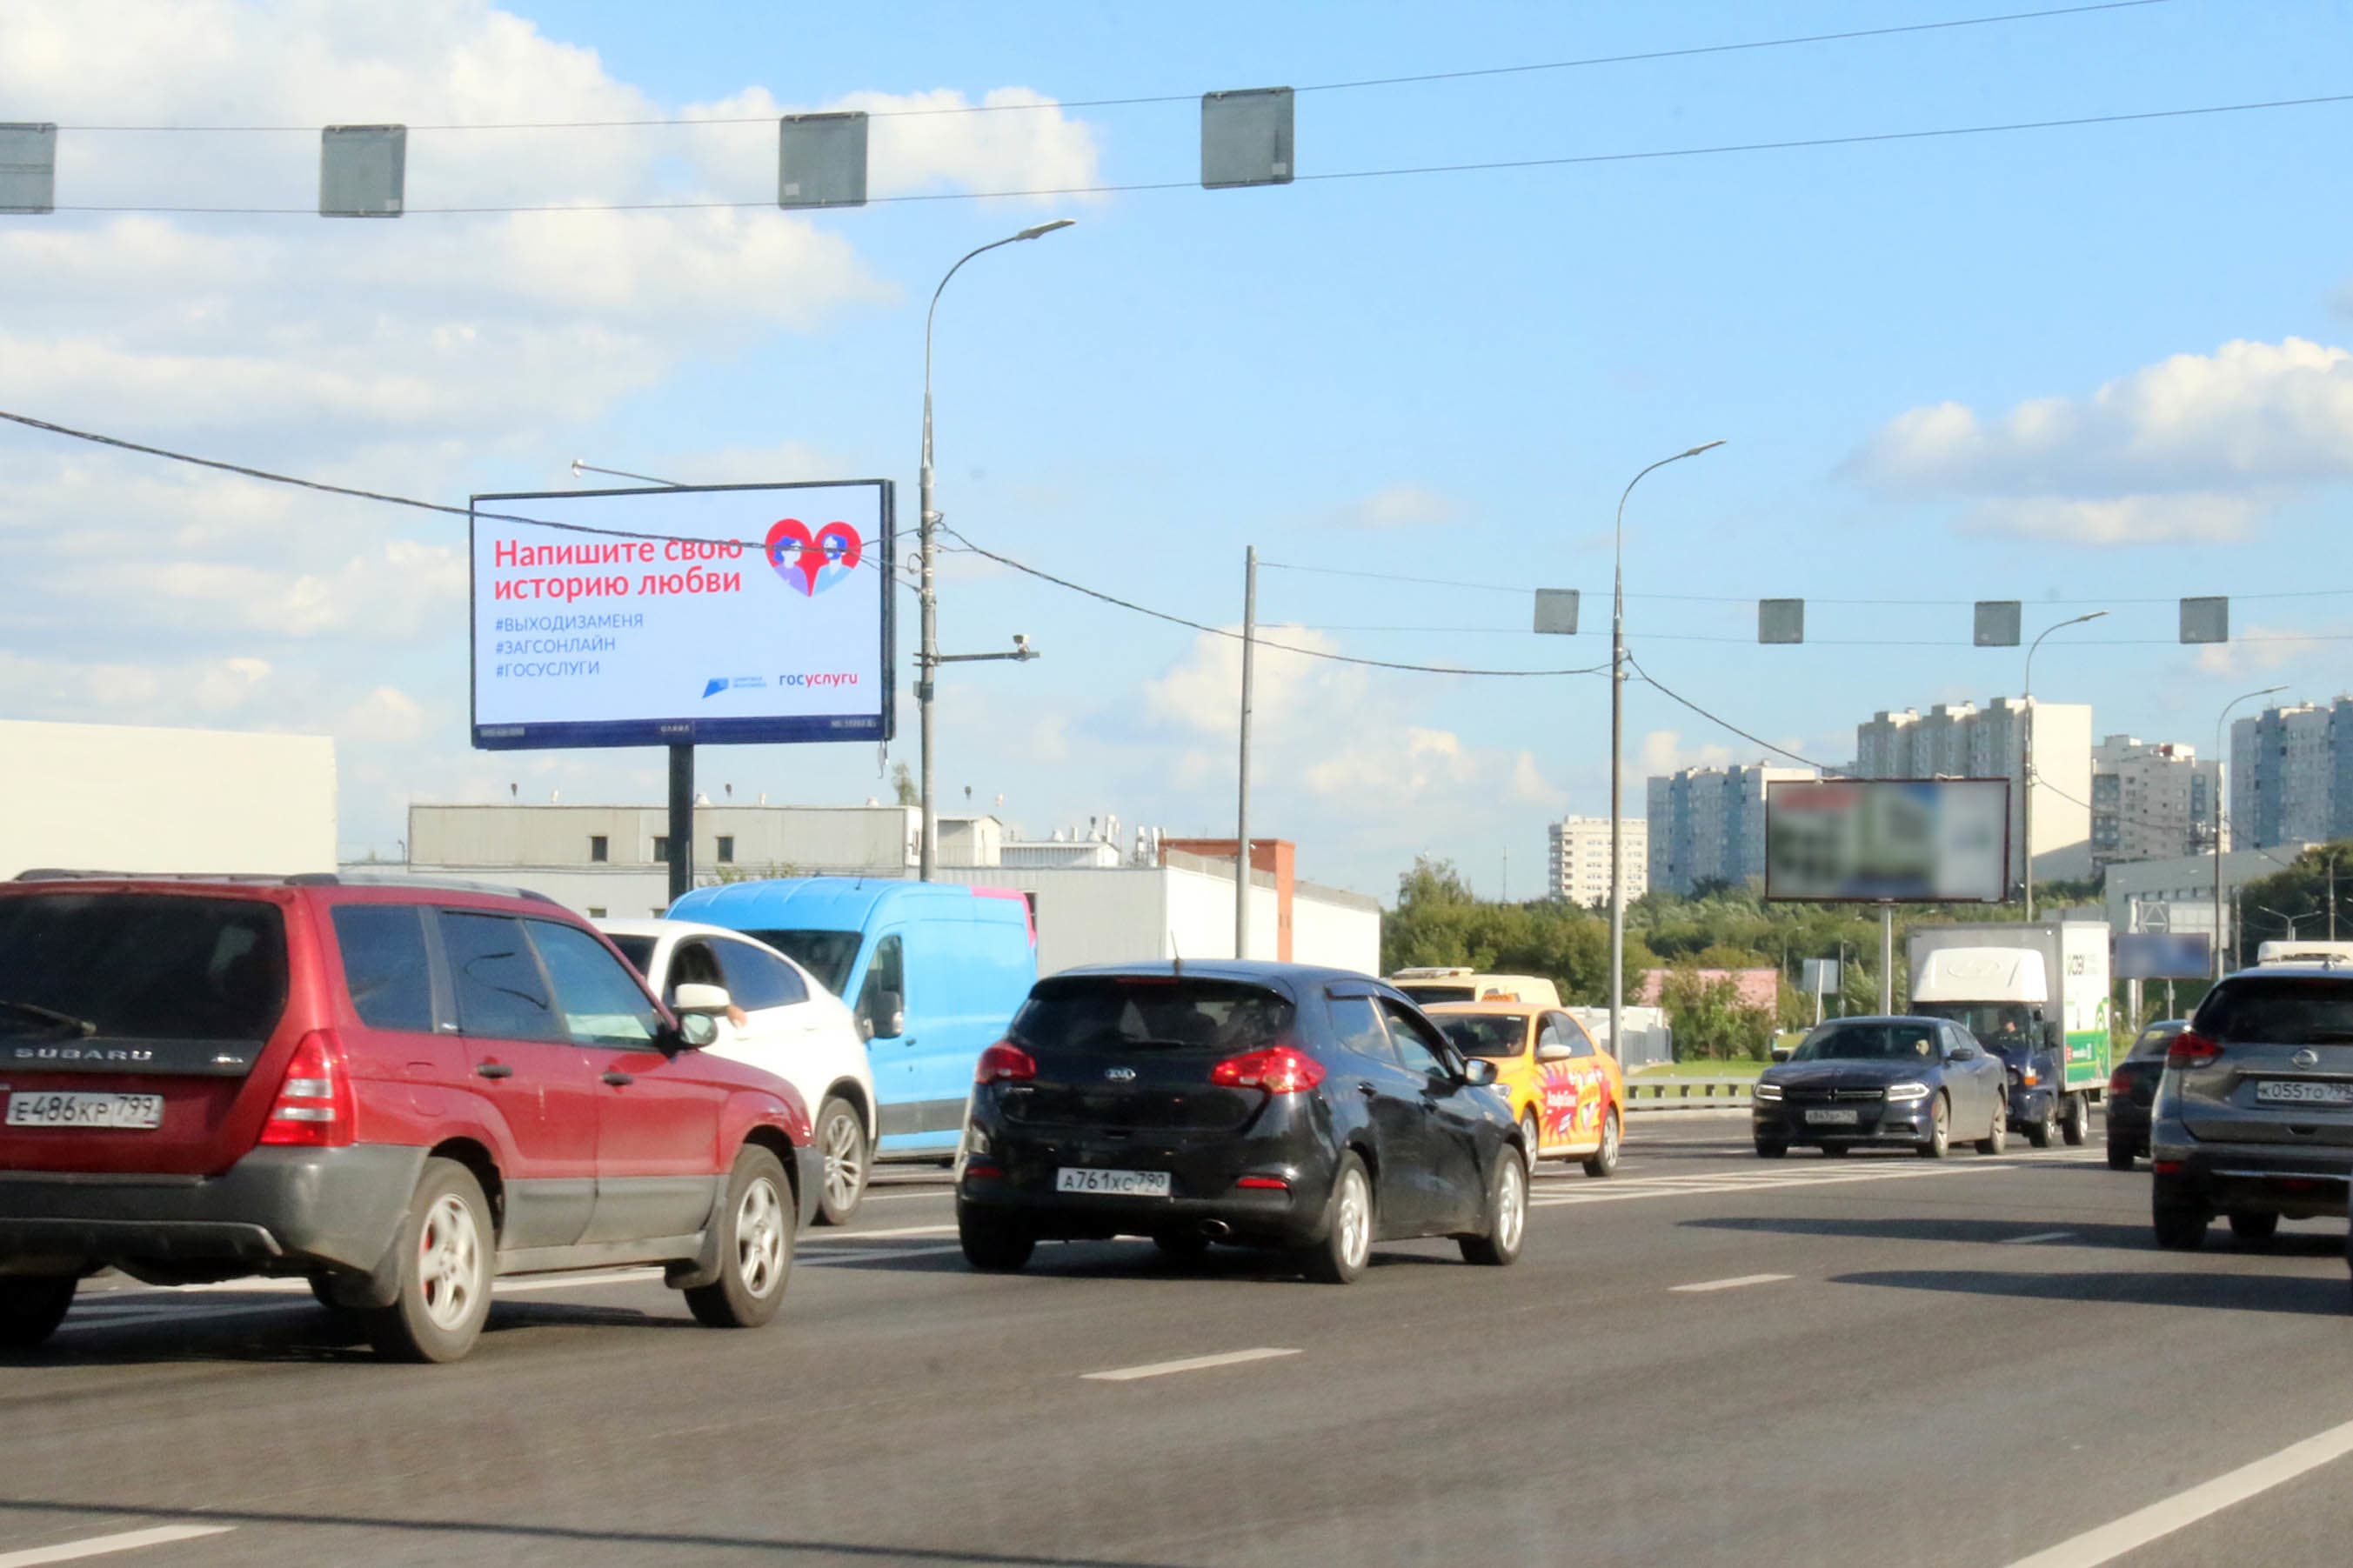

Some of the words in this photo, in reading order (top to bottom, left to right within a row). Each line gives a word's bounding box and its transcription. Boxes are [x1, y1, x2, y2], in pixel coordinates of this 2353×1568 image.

[494, 539, 655, 568] Напишите
[664, 537, 743, 562] свою
[494, 575, 629, 604] историю
[637, 565, 741, 596] любви
[495, 613, 644, 633] #ВЫХОДИЗАМЕНЯ
[495, 635, 616, 655] #ЗАГСОНЛАЙН
[496, 660, 600, 678] #ГОСУСЛУГИ
[779, 673, 858, 688] госуслуги
[14, 1047, 153, 1061] SUBARU
